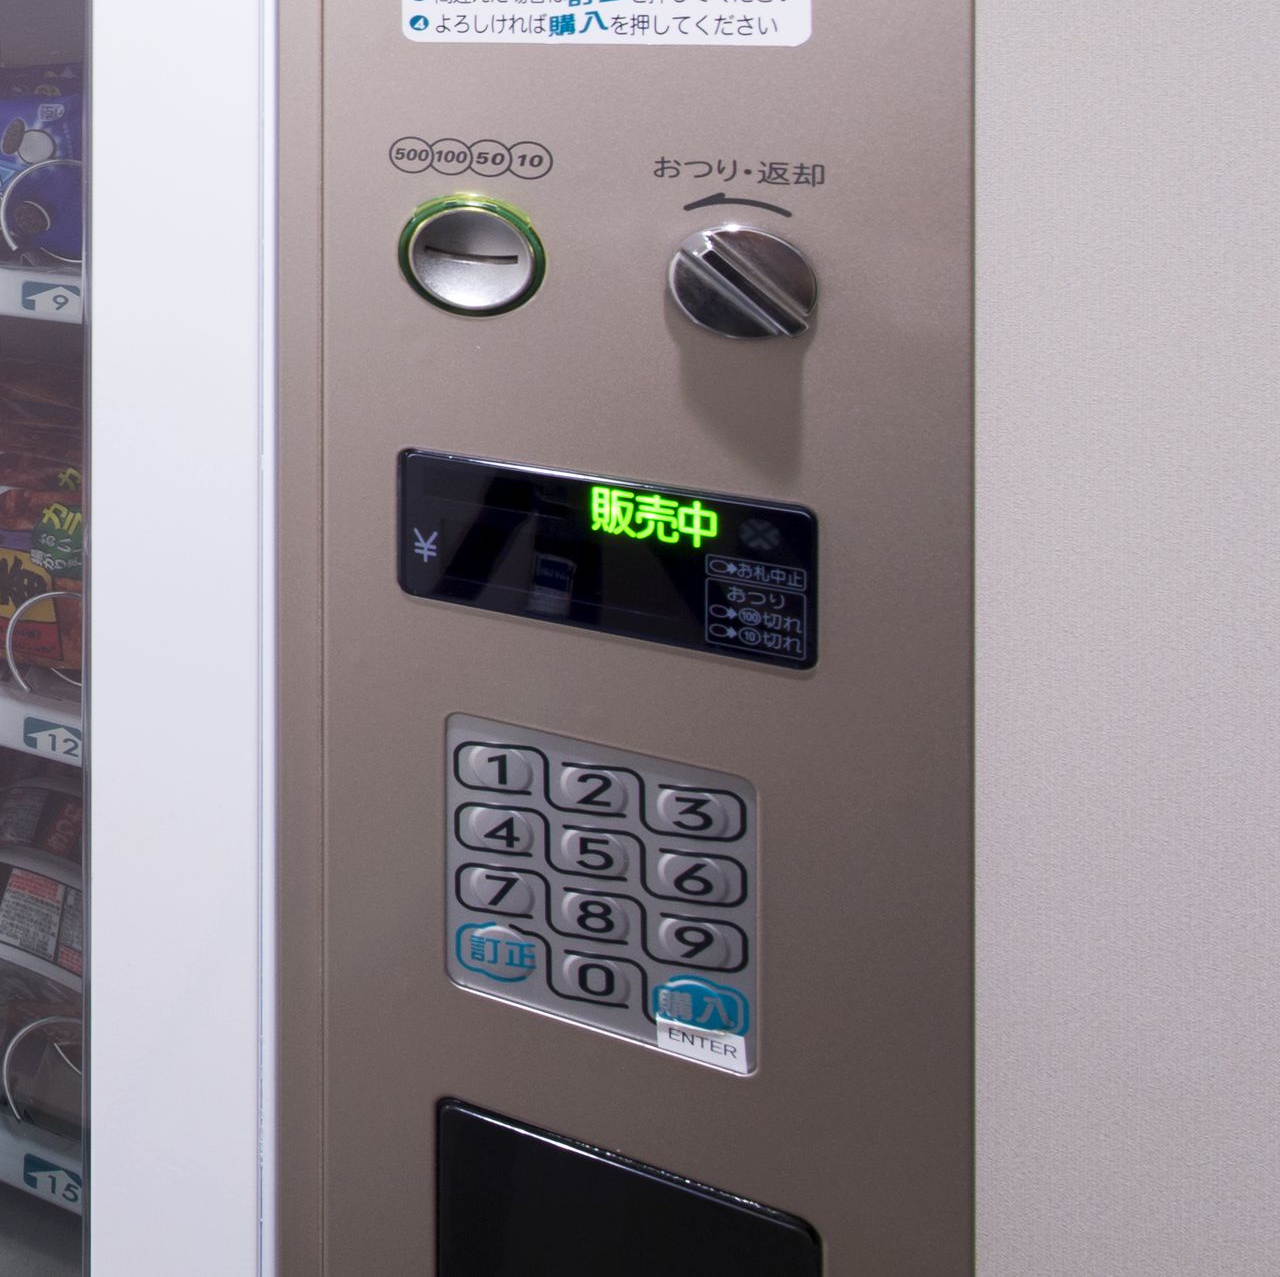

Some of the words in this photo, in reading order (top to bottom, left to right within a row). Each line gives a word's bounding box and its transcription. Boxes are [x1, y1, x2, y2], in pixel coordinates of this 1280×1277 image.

[435, 10, 778, 38] よろしければ購入を押してください
[393, 147, 430, 162] 500
[435, 148, 468, 164] 100
[474, 151, 505, 166] 50
[516, 153, 544, 169] 10
[653, 155, 826, 188] おつり・返却
[53, 294, 69, 310] 9
[590, 485, 718, 548] 販売中
[735, 560, 804, 588] お札中止
[726, 585, 786, 610] おつり
[761, 610, 803, 634] 切れ
[761, 631, 803, 654] 切れ
[48, 732, 80, 758] 12
[487, 754, 507, 785] 1
[576, 773, 613, 807] 2
[672, 796, 713, 831] 3
[484, 816, 520, 848] 4
[576, 837, 614, 871] 5
[484, 874, 520, 906] 7
[674, 863, 713, 896] 6
[576, 899, 615, 933] 8
[470, 935, 537, 969] 訂正
[675, 925, 714, 959] 9
[577, 962, 615, 997] 0
[668, 1027, 738, 1059] ENTER
[48, 1174, 80, 1203] 15
